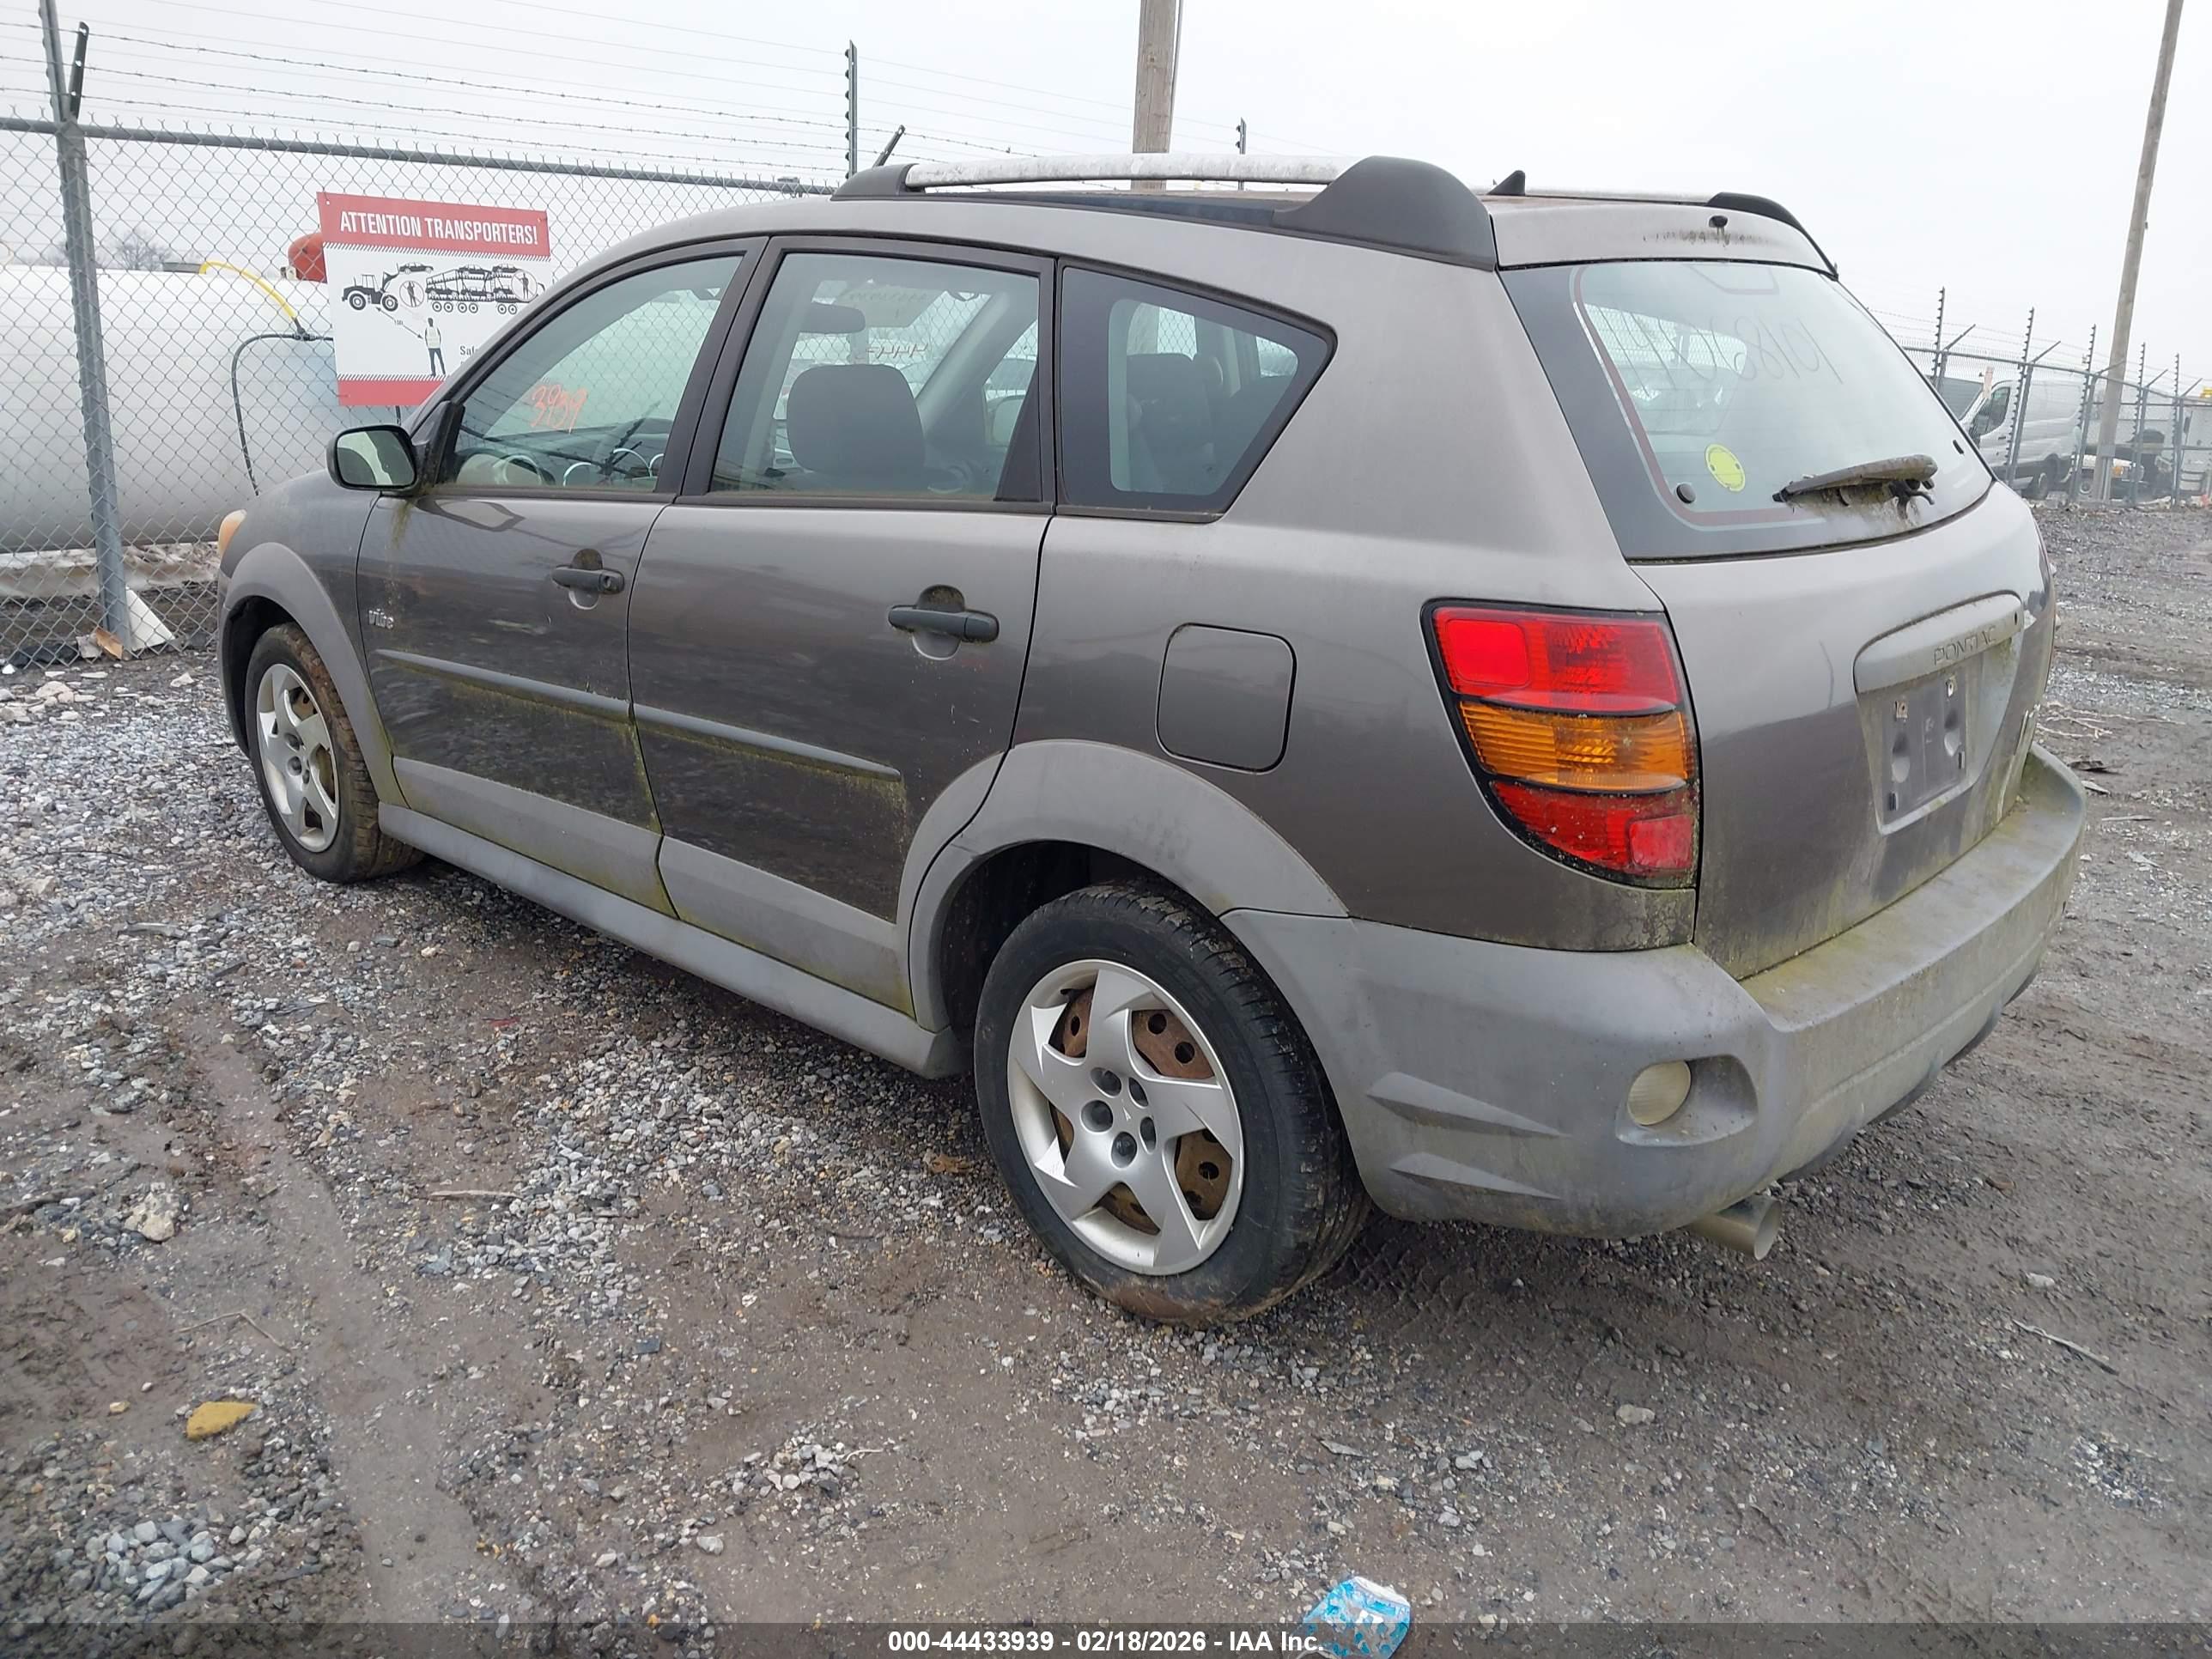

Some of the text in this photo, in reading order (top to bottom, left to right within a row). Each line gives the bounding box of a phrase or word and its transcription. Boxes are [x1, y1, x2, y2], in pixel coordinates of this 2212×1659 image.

[339, 210, 539, 246] ATTENTION TRANSPORTERS!
[1934, 625, 1996, 666] PONTIAC
